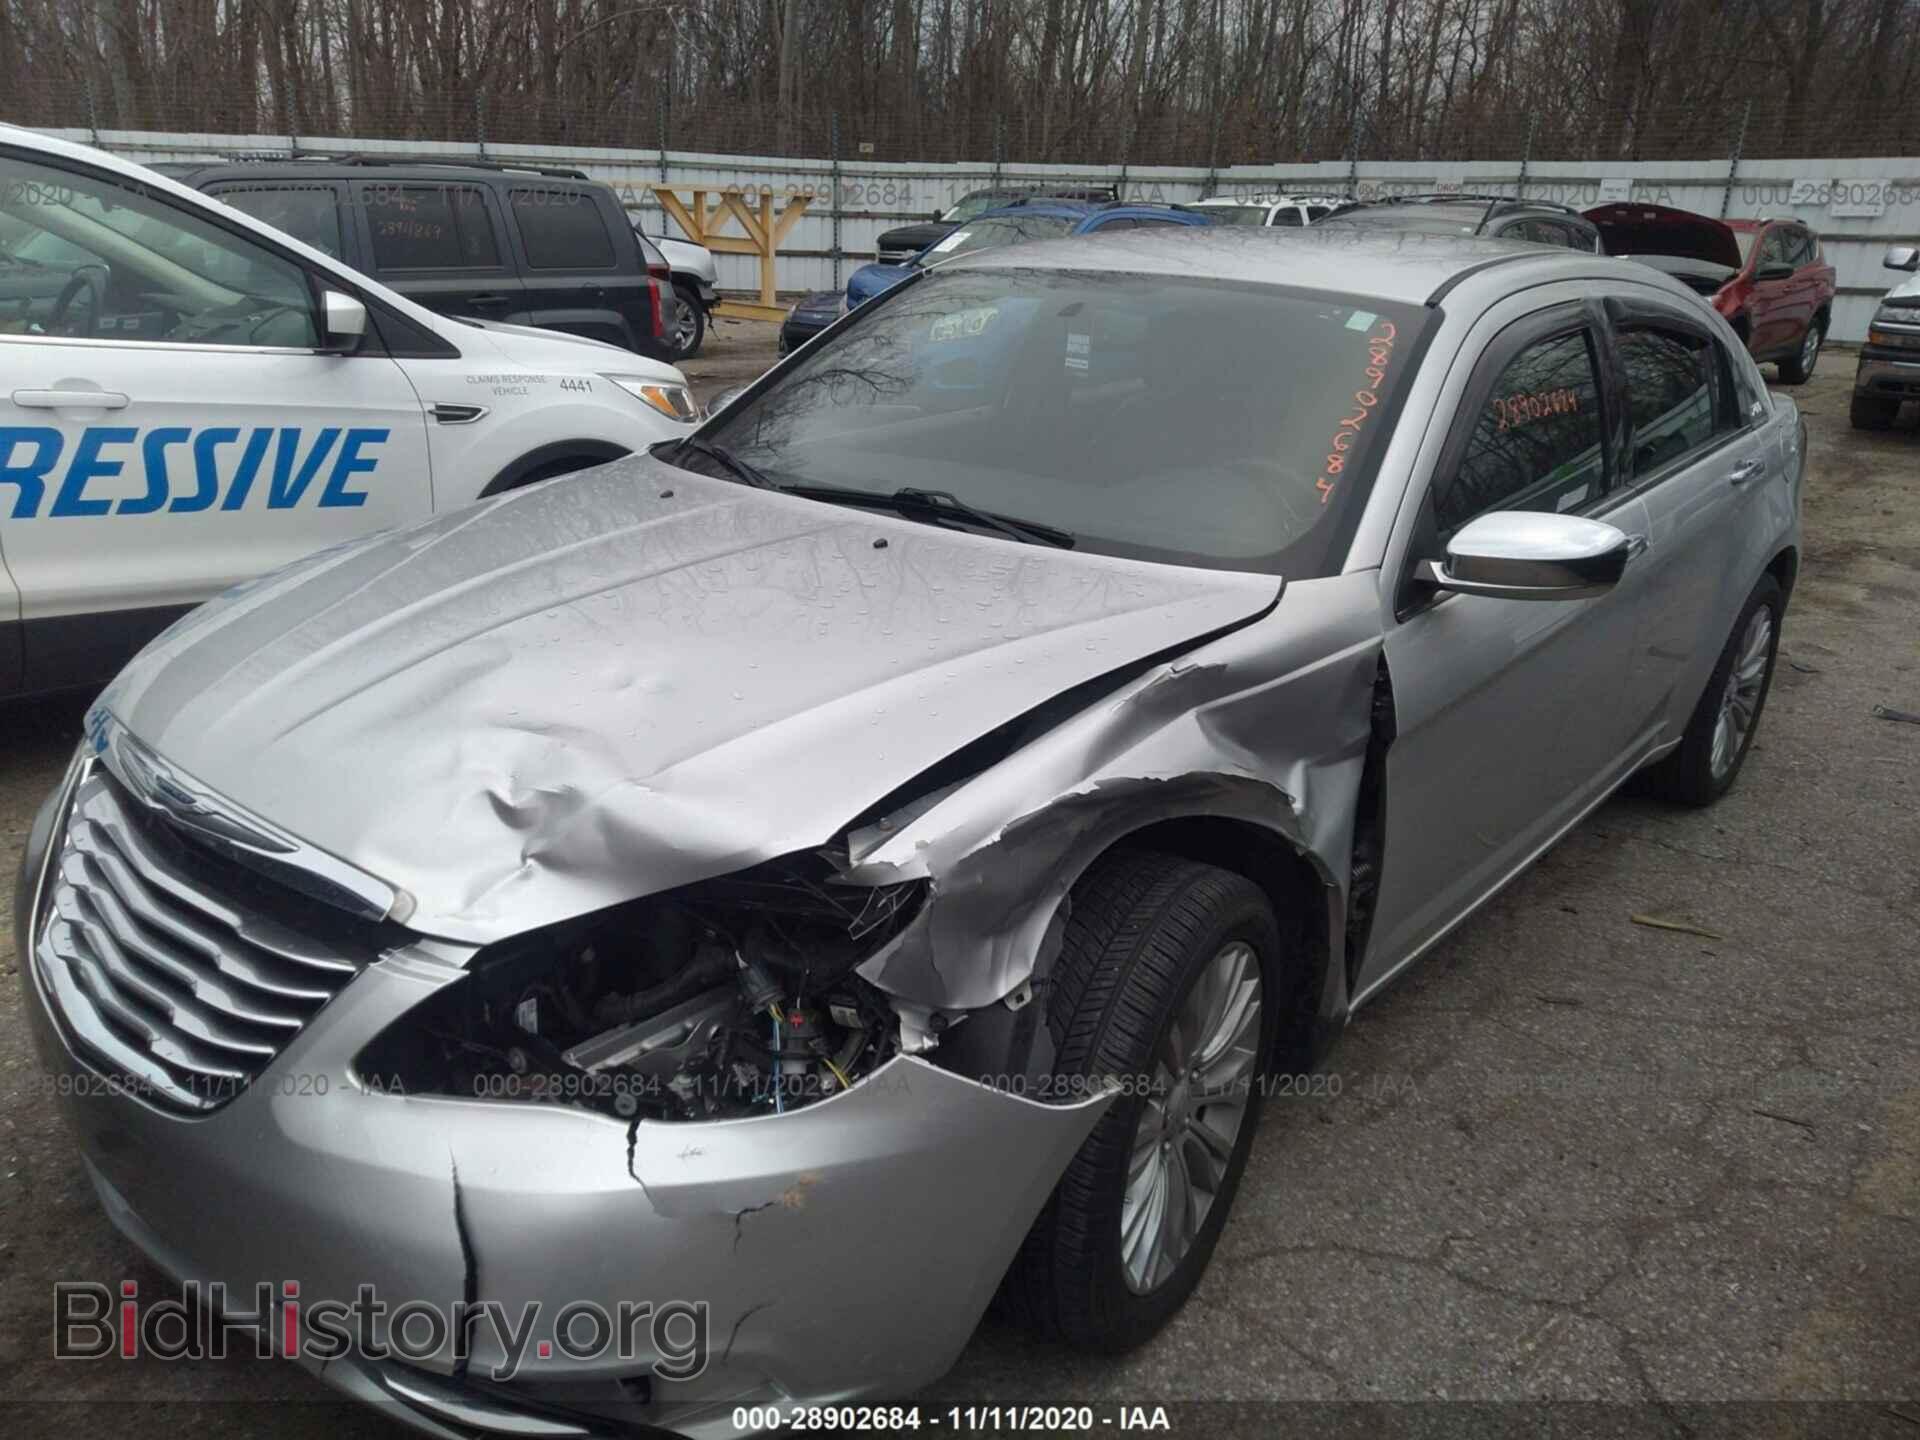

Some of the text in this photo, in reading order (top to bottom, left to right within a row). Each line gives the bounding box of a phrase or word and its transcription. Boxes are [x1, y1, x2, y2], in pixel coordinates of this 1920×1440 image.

[466, 375, 547, 385] CLAIMS RESPONSE
[559, 378, 593, 393] 4441
[491, 386, 529, 396] VEHICLE
[0, 427, 391, 519] RESSIVE
